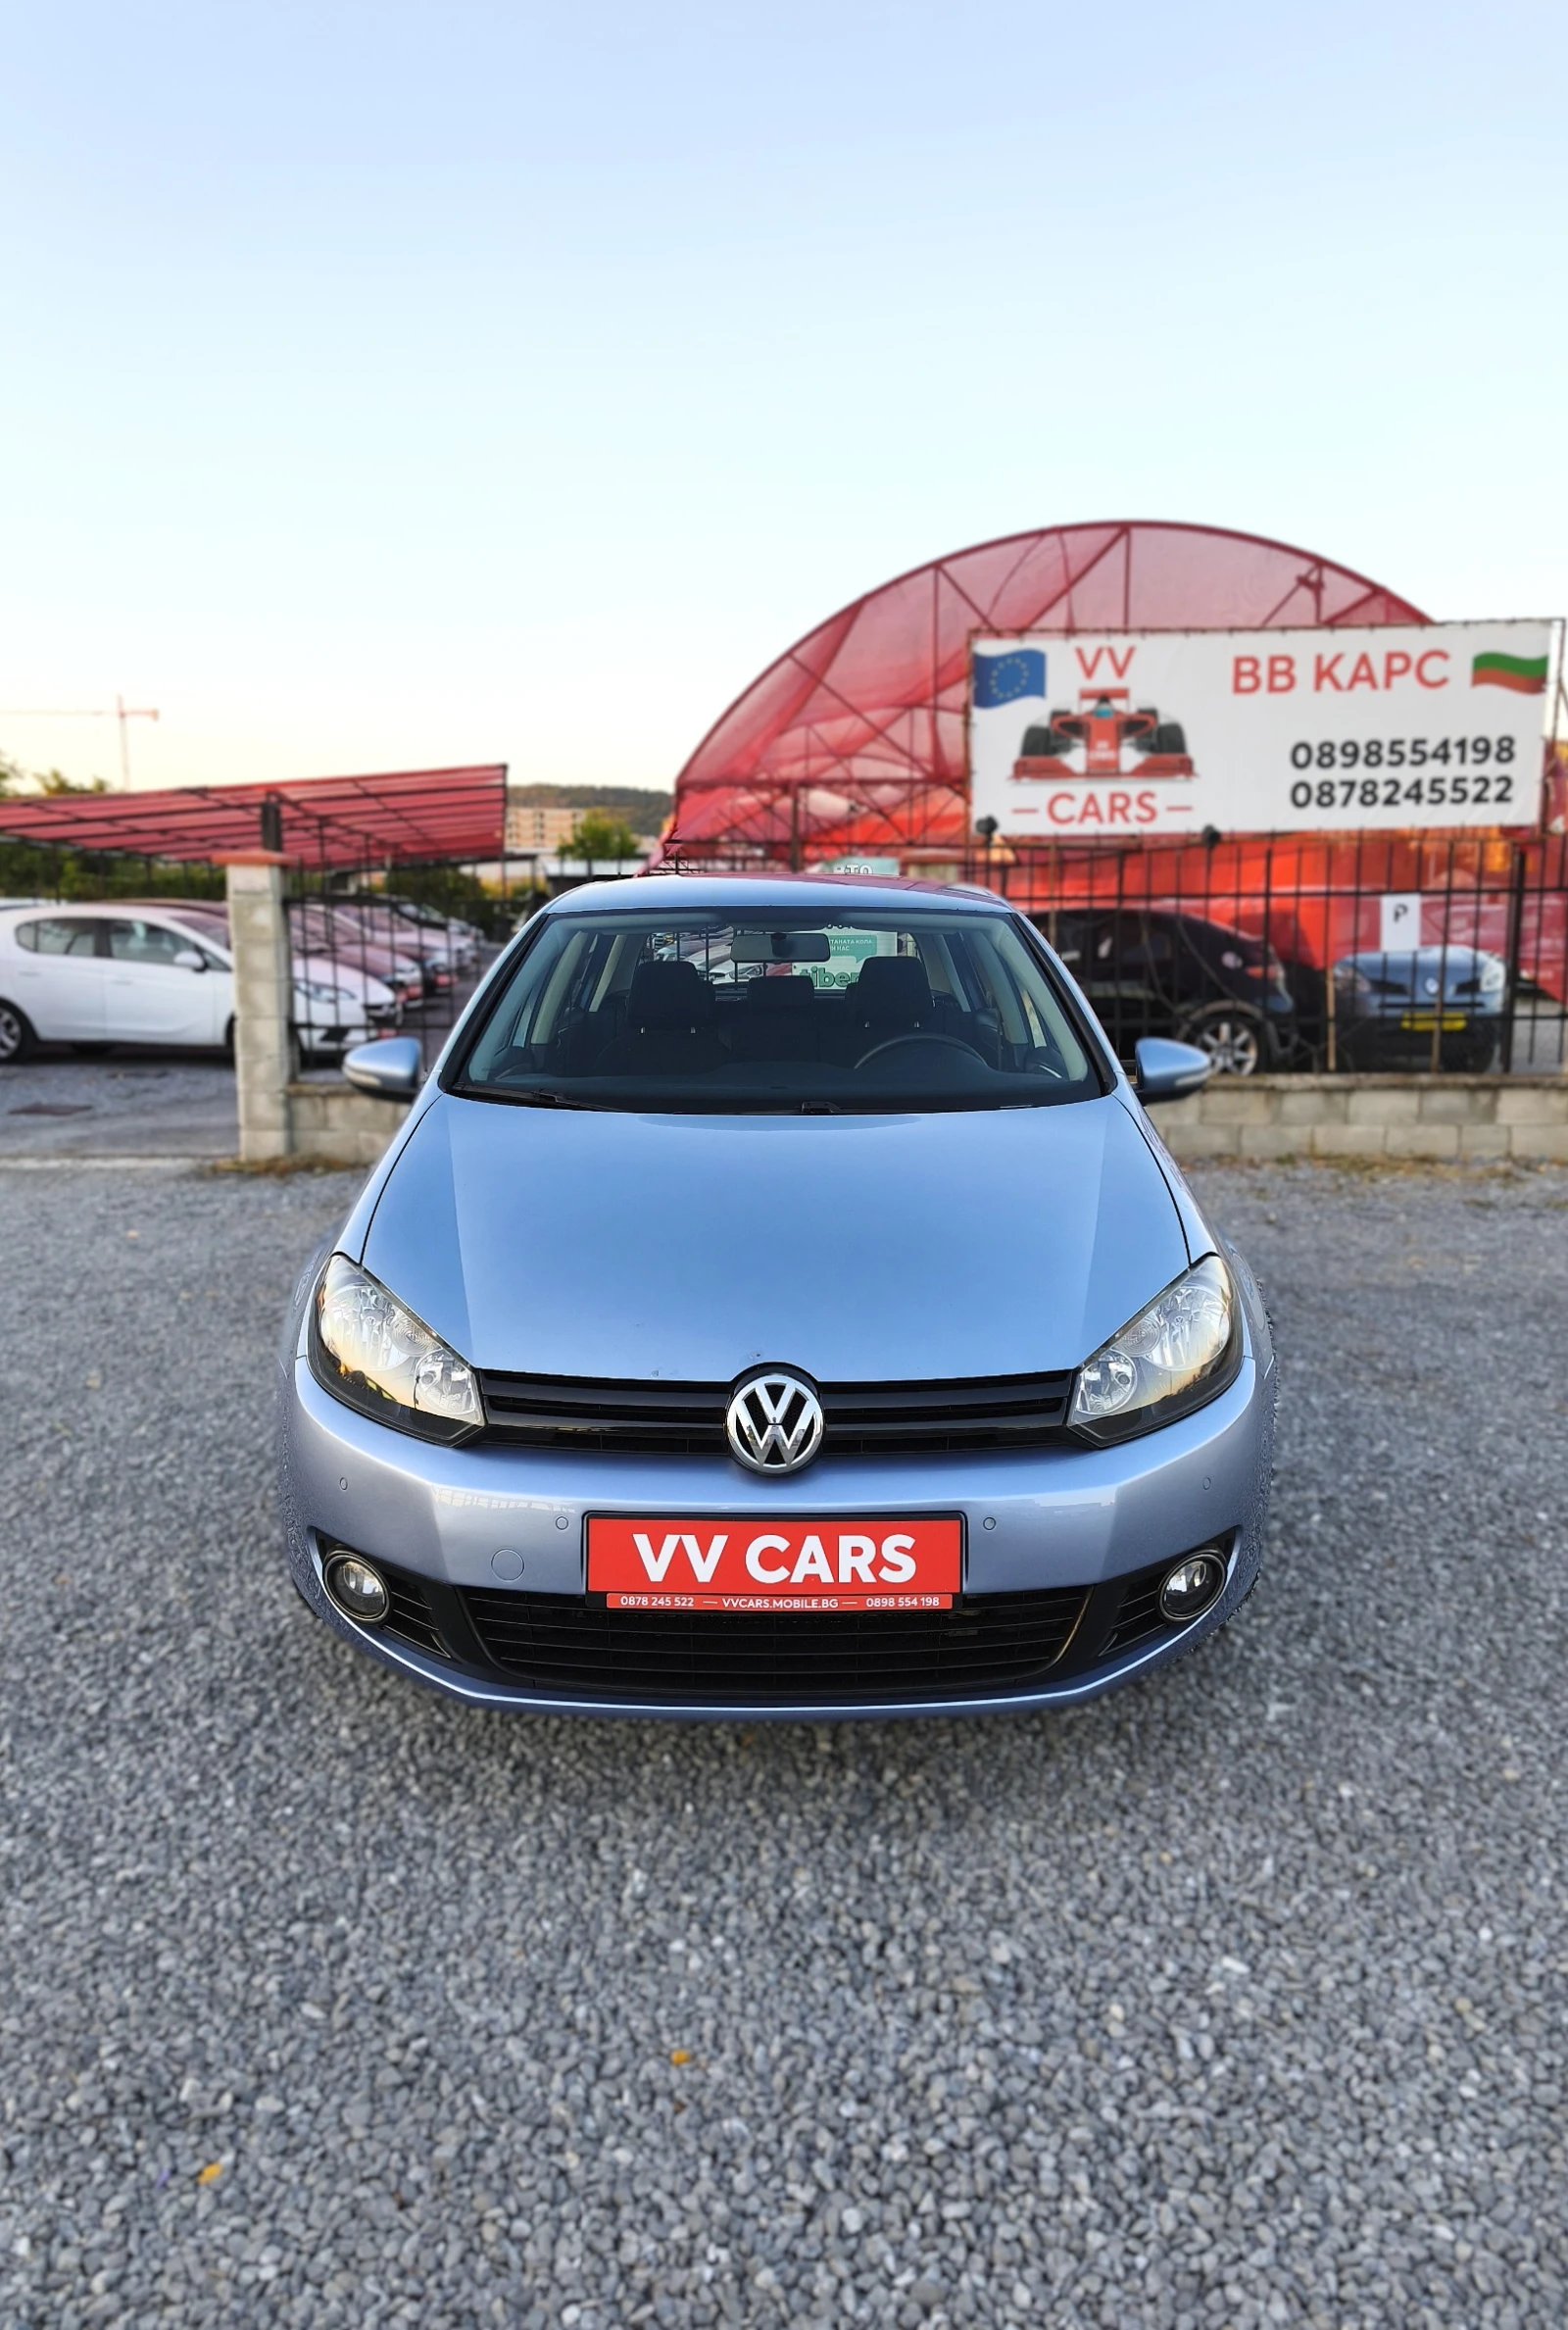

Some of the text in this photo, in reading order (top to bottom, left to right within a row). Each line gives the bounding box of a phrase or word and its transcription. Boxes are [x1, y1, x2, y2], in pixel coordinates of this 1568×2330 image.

[1075, 646, 1135, 679] VV
[1232, 649, 1449, 695] ВВ КАРС
[1291, 735, 1515, 769] 0898554198
[1047, 791, 1157, 825] CARS
[1291, 775, 1513, 809] 0878245522
[632, 1533, 916, 1584] VV CARS
[619, 1595, 941, 1610] 0878 245 522 VVCARS.MOBILE.BG 0898 554 198
